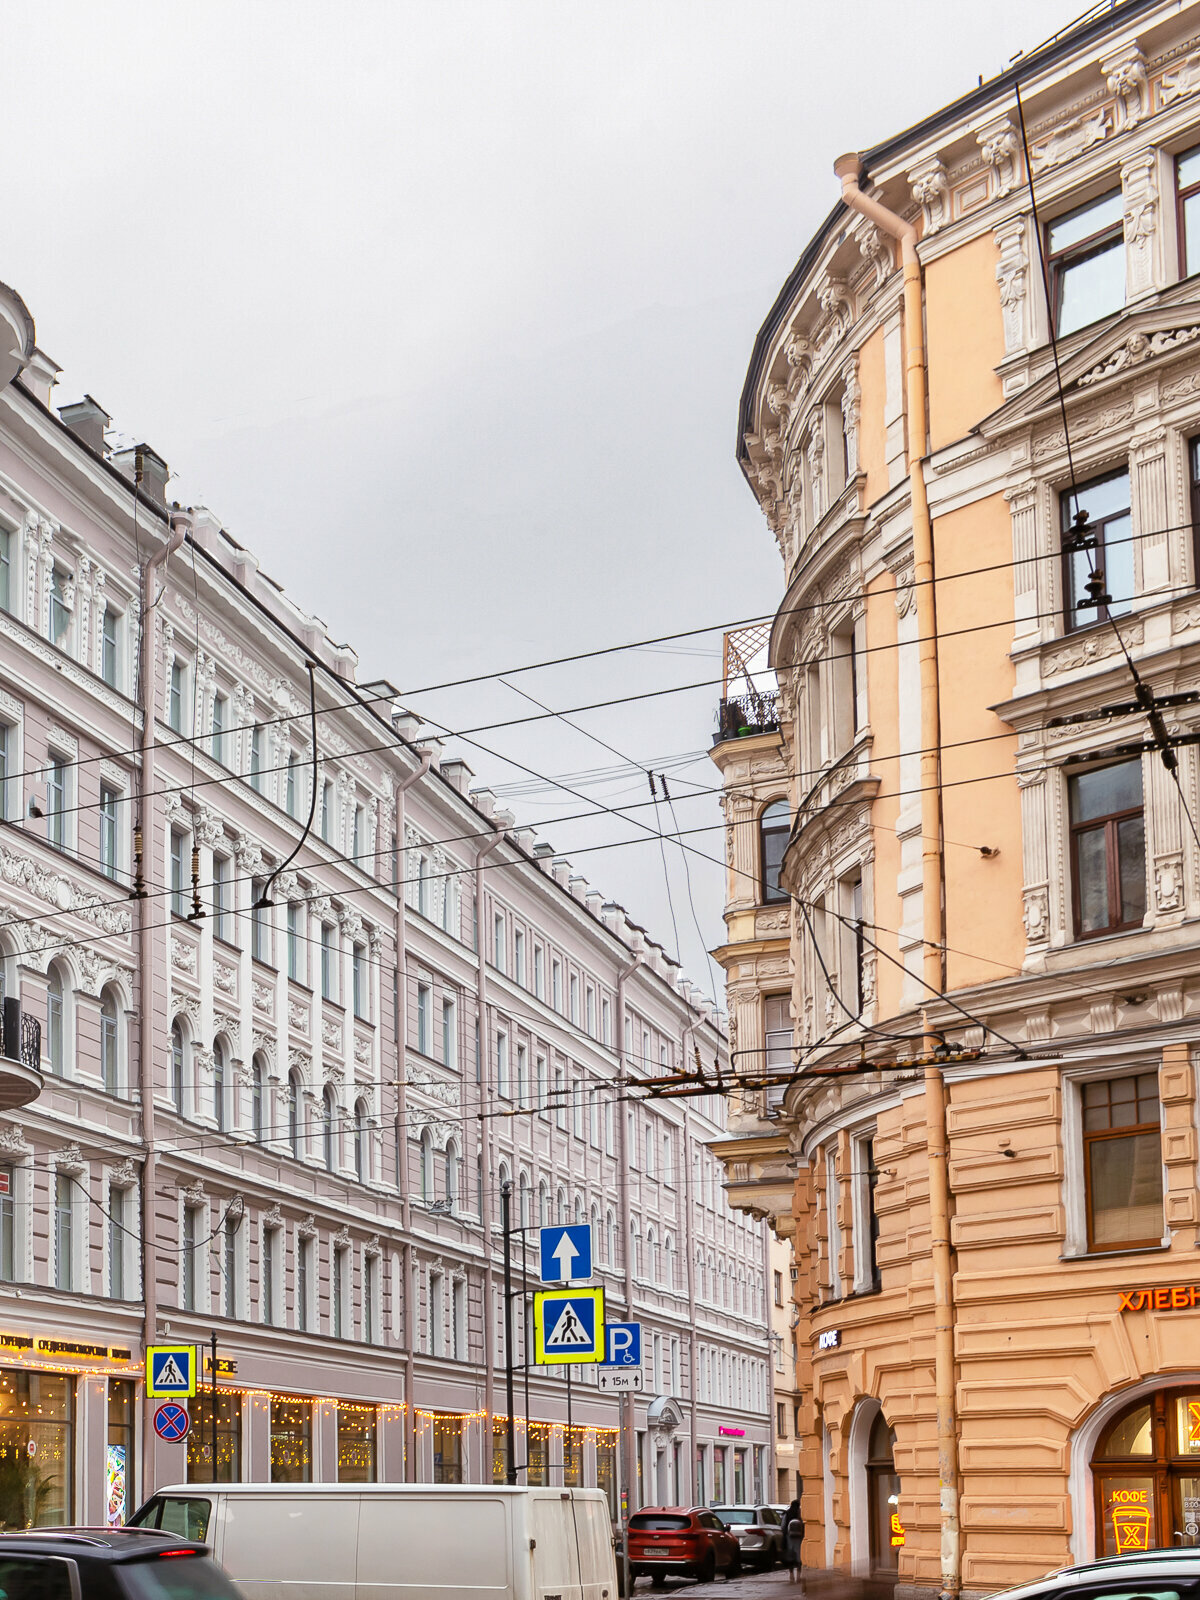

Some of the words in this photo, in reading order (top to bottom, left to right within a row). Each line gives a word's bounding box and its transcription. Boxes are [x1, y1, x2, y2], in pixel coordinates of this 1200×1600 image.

[610, 1328, 633, 1361] P
[819, 1330, 837, 1349] КОФЕ
[1112, 1490, 1148, 1503] КОФЕ
